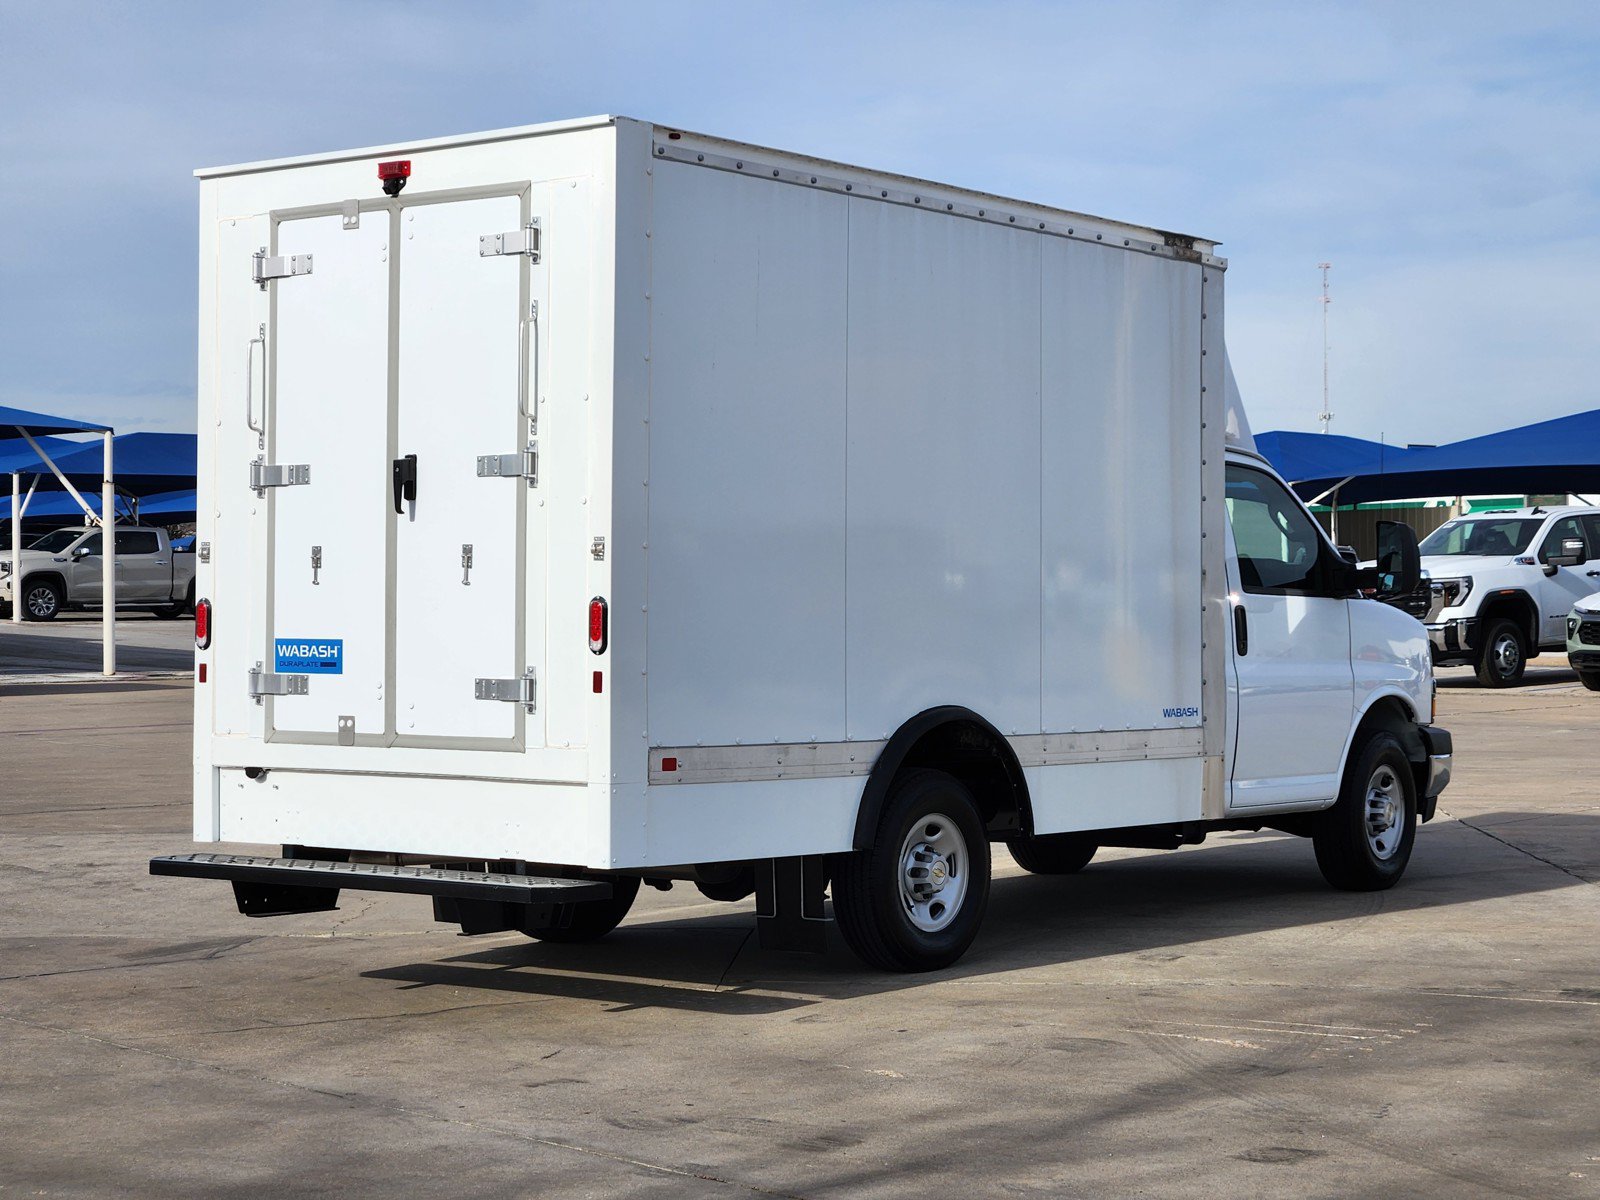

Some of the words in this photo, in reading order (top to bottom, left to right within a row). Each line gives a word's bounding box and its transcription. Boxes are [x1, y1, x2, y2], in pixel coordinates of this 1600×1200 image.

[277, 644, 338, 658] WABASH
[279, 660, 319, 668] DURAPLATE
[1162, 707, 1199, 718] WABASH
